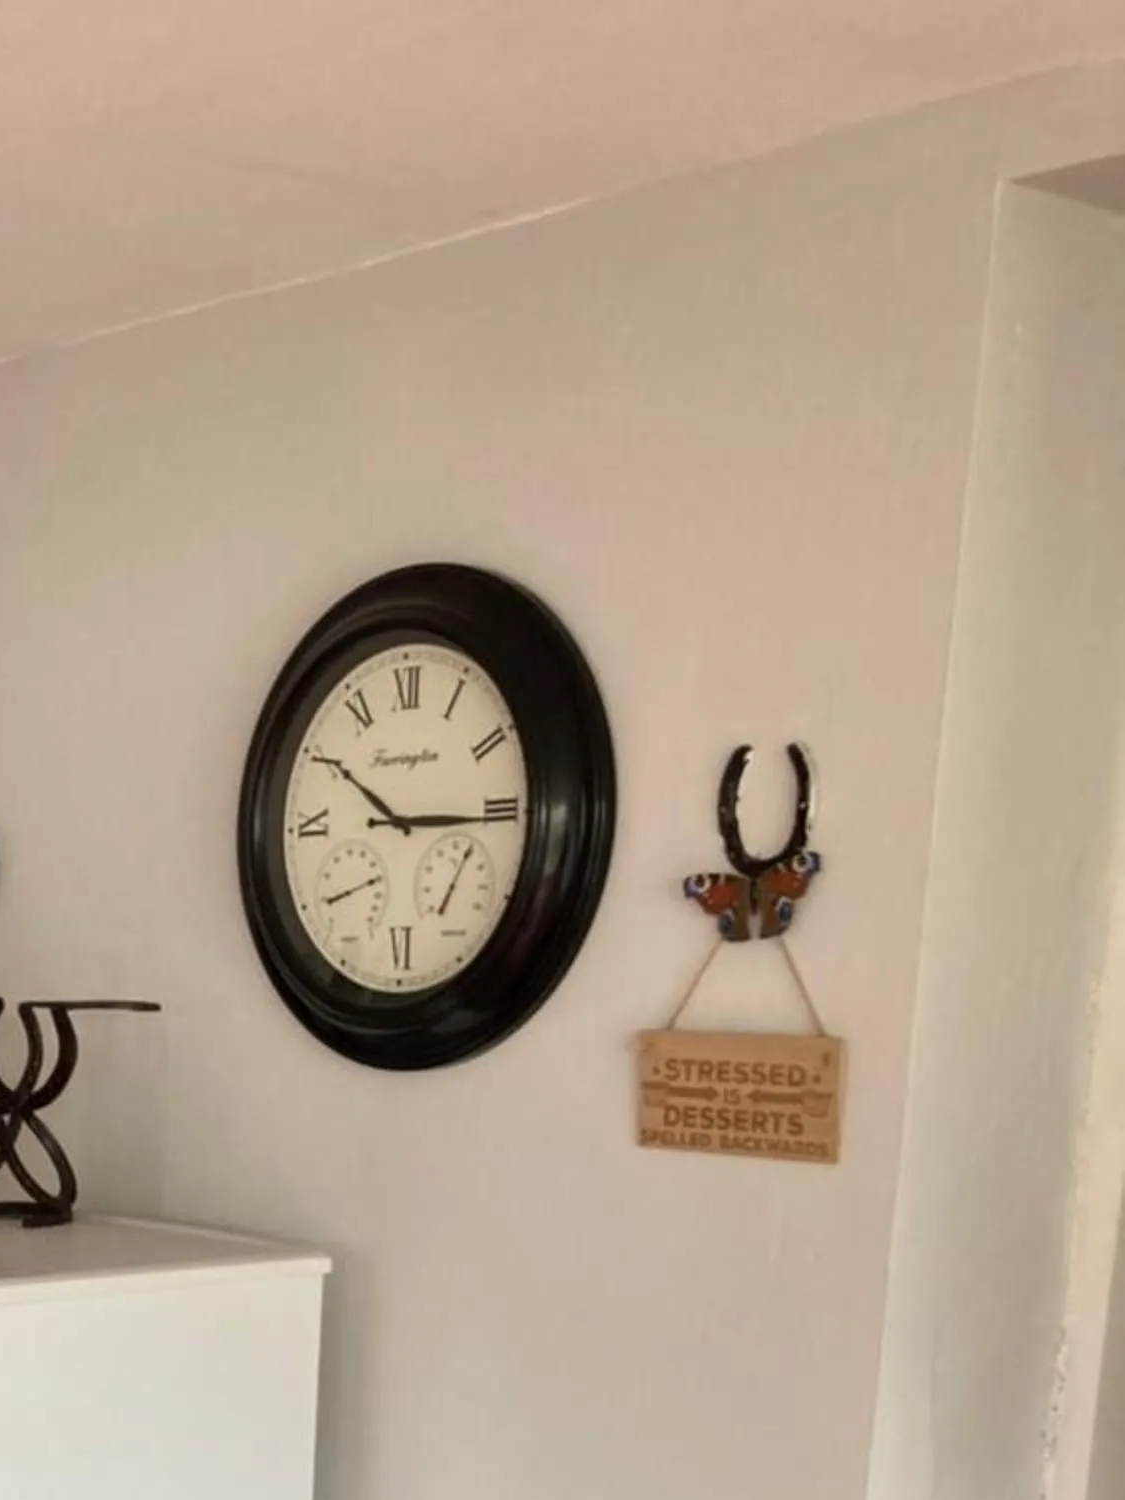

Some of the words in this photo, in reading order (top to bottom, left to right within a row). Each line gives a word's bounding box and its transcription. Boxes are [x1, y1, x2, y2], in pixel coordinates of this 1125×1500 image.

[391, 665, 421, 712] XII
[443, 679, 467, 721] I
[344, 689, 374, 738] XI
[472, 725, 507, 764] II
[297, 808, 329, 839] IX
[483, 796, 519, 824] III
[389, 926, 413, 971] VI
[662, 1057, 806, 1087] STRESSED
[723, 1087, 742, 1105] IS
[662, 1104, 805, 1136] DESSERTS
[640, 1128, 712, 1149] SPELLED
